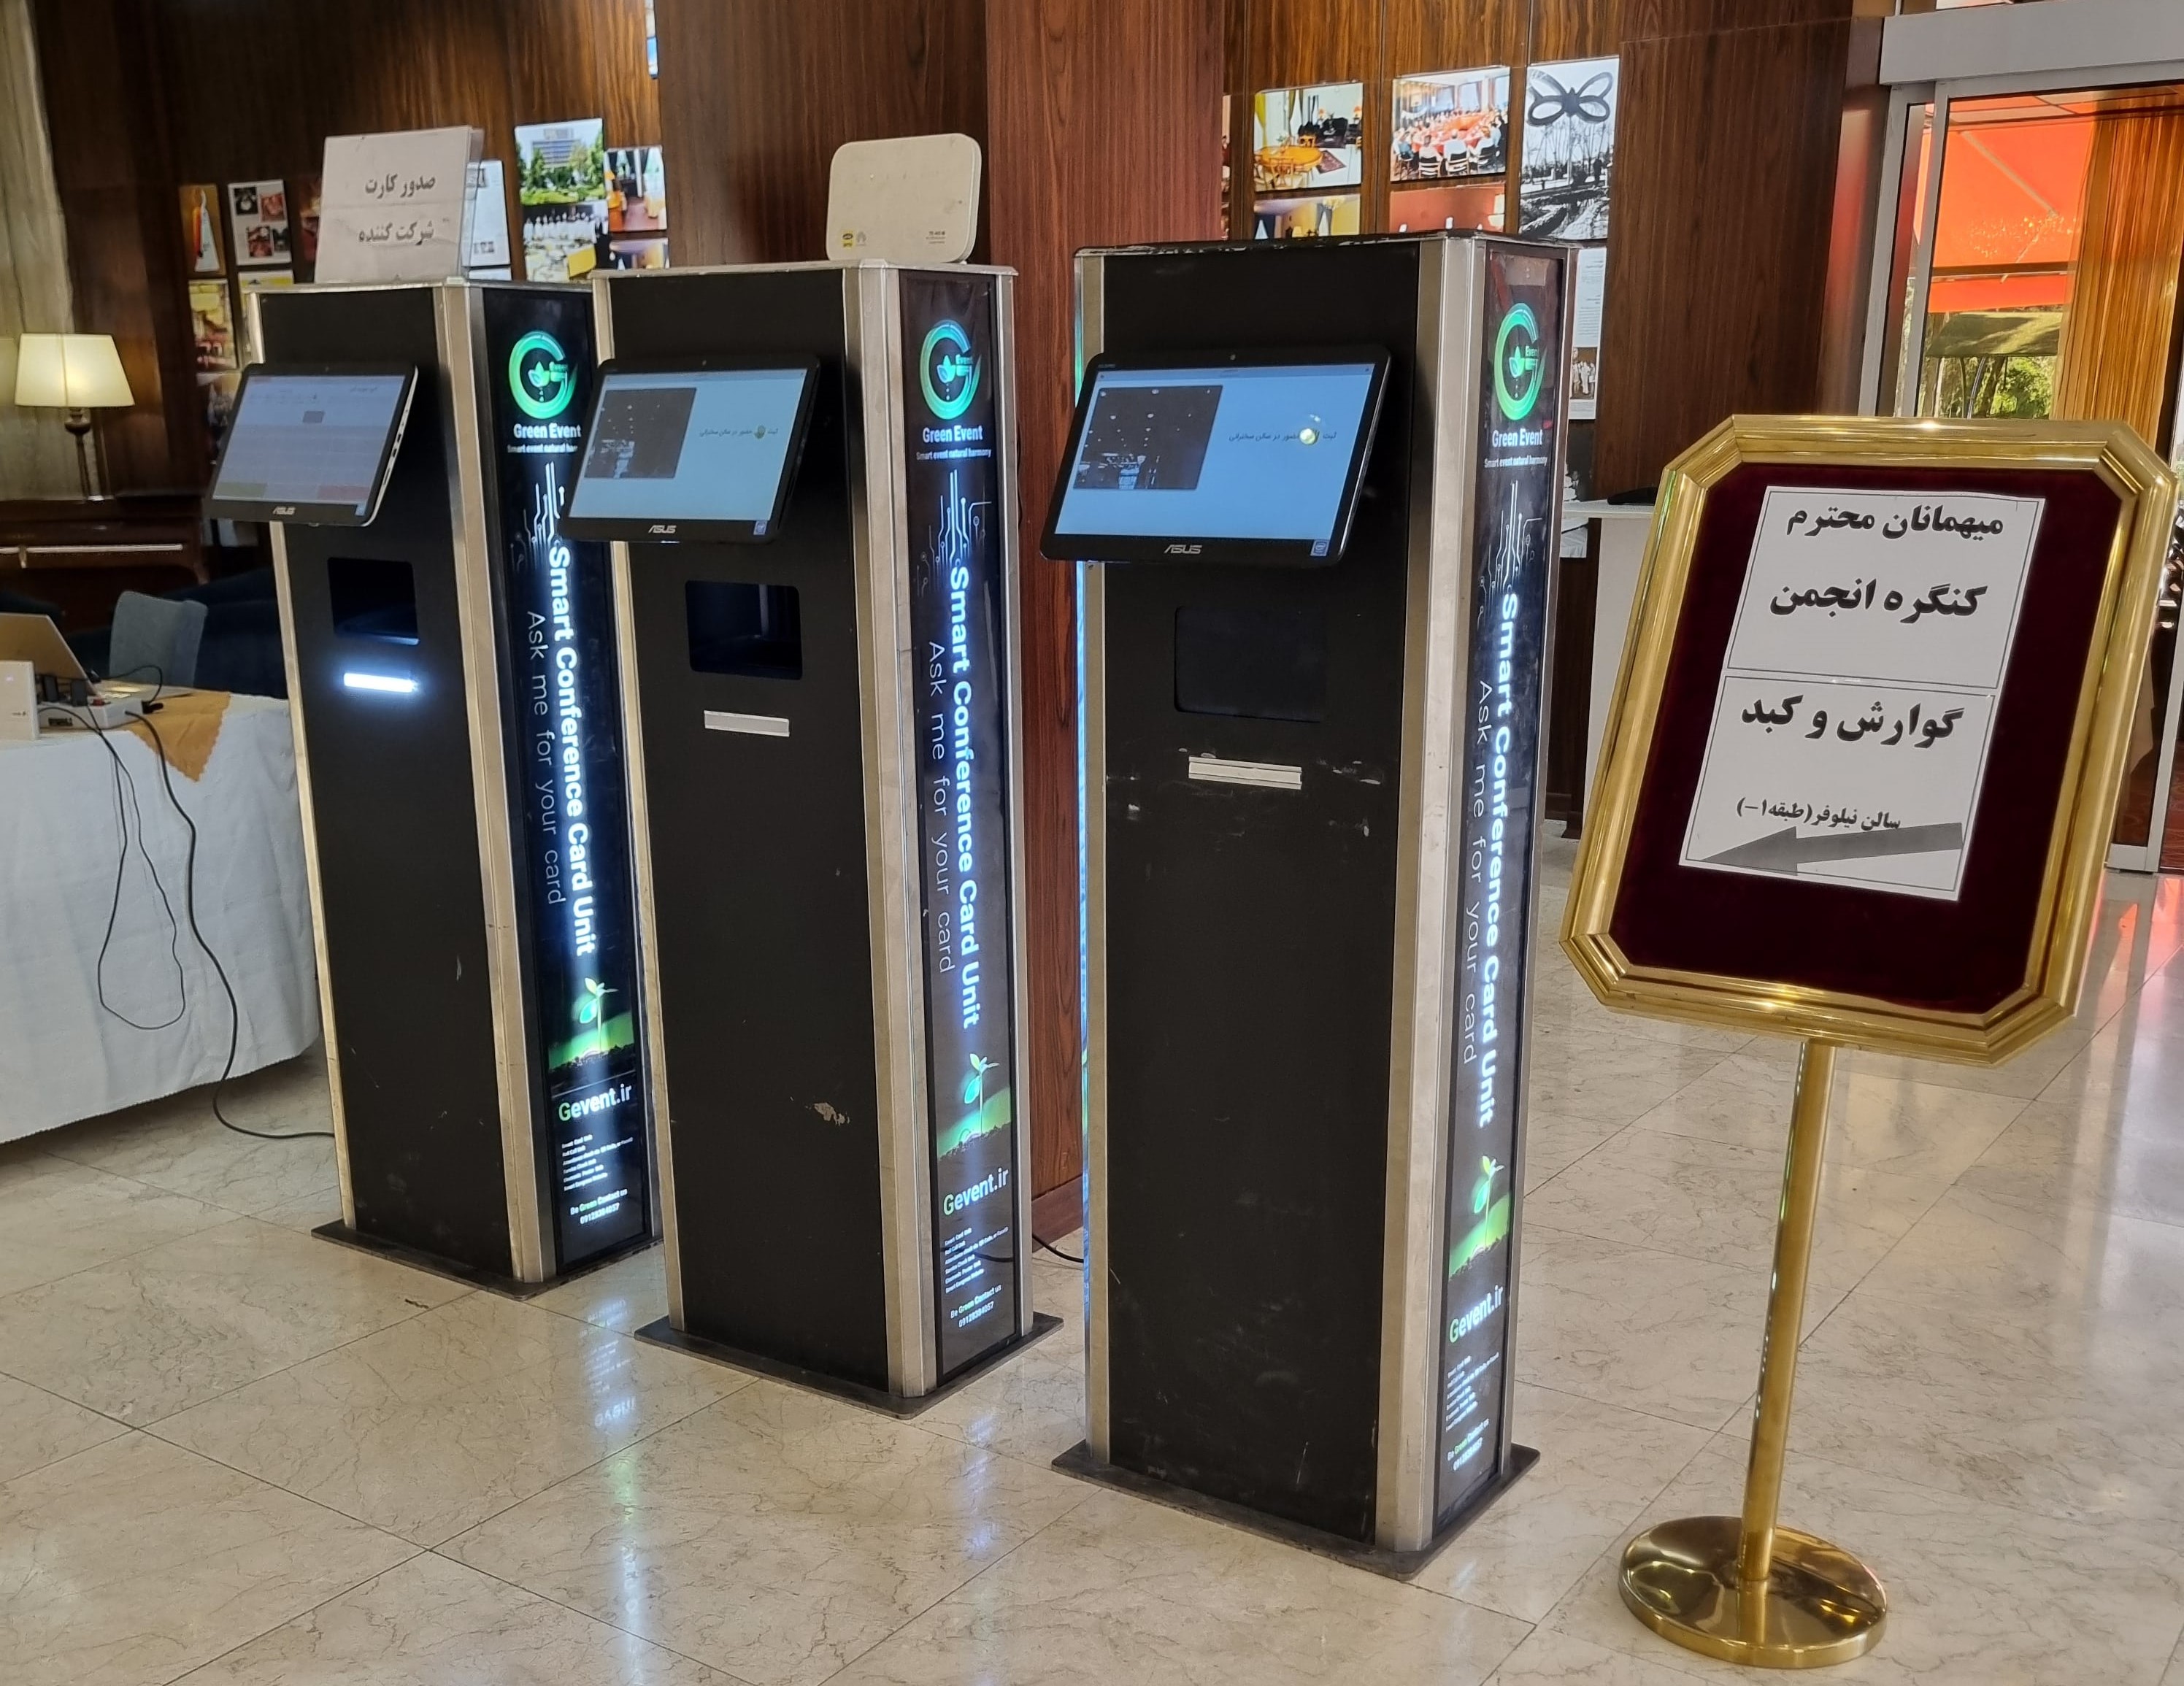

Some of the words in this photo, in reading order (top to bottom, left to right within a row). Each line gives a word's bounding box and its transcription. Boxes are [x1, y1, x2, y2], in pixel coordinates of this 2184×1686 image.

[365, 173, 398, 199] کارت
[399, 176, 436, 198] صدور
[358, 222, 393, 242] کننده
[396, 220, 434, 245] شرکت
[513, 423, 547, 438] Green
[549, 423, 582, 438] Event
[923, 427, 952, 443] Green
[953, 425, 983, 442] Event
[1492, 430, 1518, 447] Green
[1519, 428, 1543, 445] Event
[916, 451, 933, 461] Smart
[1484, 458, 1499, 468] Smart
[1499, 457, 1513, 467] event
[272, 506, 296, 515] ASUS
[648, 525, 677, 534] ASUS
[1786, 507, 1875, 537] محترم
[1882, 504, 2004, 542] میهمانان
[1164, 544, 1203, 555] ASUS
[549, 546, 574, 642] Smart
[1770, 578, 1877, 617] انجمن
[1883, 583, 1988, 624] کنگره
[527, 611, 549, 660] Ask
[950, 566, 970, 674] Smart
[928, 641, 947, 697] Ask
[1497, 593, 1518, 717] Smart
[531, 674, 547, 715] me
[1477, 680, 1493, 744] Ask
[1742, 694, 1804, 734] کبد
[555, 647, 583, 817] Conference
[931, 713, 945, 760] me
[1804, 709, 1829, 739] و
[1837, 701, 1965, 749] گوارش
[536, 730, 555, 766] for
[934, 775, 950, 816] for
[953, 680, 974, 872] Conference
[1473, 764, 1486, 818] me
[535, 780, 557, 836] your
[1861, 811, 1902, 831] سالن
[568, 823, 593, 891] Card
[1471, 836, 1486, 883] for
[1486, 725, 1511, 947] Conference
[545, 850, 566, 904] card
[931, 831, 950, 895] your
[573, 896, 596, 956] Unit
[959, 879, 980, 956] Card
[1466, 901, 1480, 973] your
[937, 912, 956, 974] card
[962, 961, 981, 1029] Unit
[1483, 955, 1499, 1044] Card
[1464, 993, 1477, 1065] card
[558, 1083, 632, 1122] Gevent.ir
[1479, 1049, 1496, 1129] Unit
[943, 1168, 1009, 1216] Gevent.ir
[958, 1300, 974, 1314] Green
[1448, 1285, 1504, 1344] Gevent.ir
